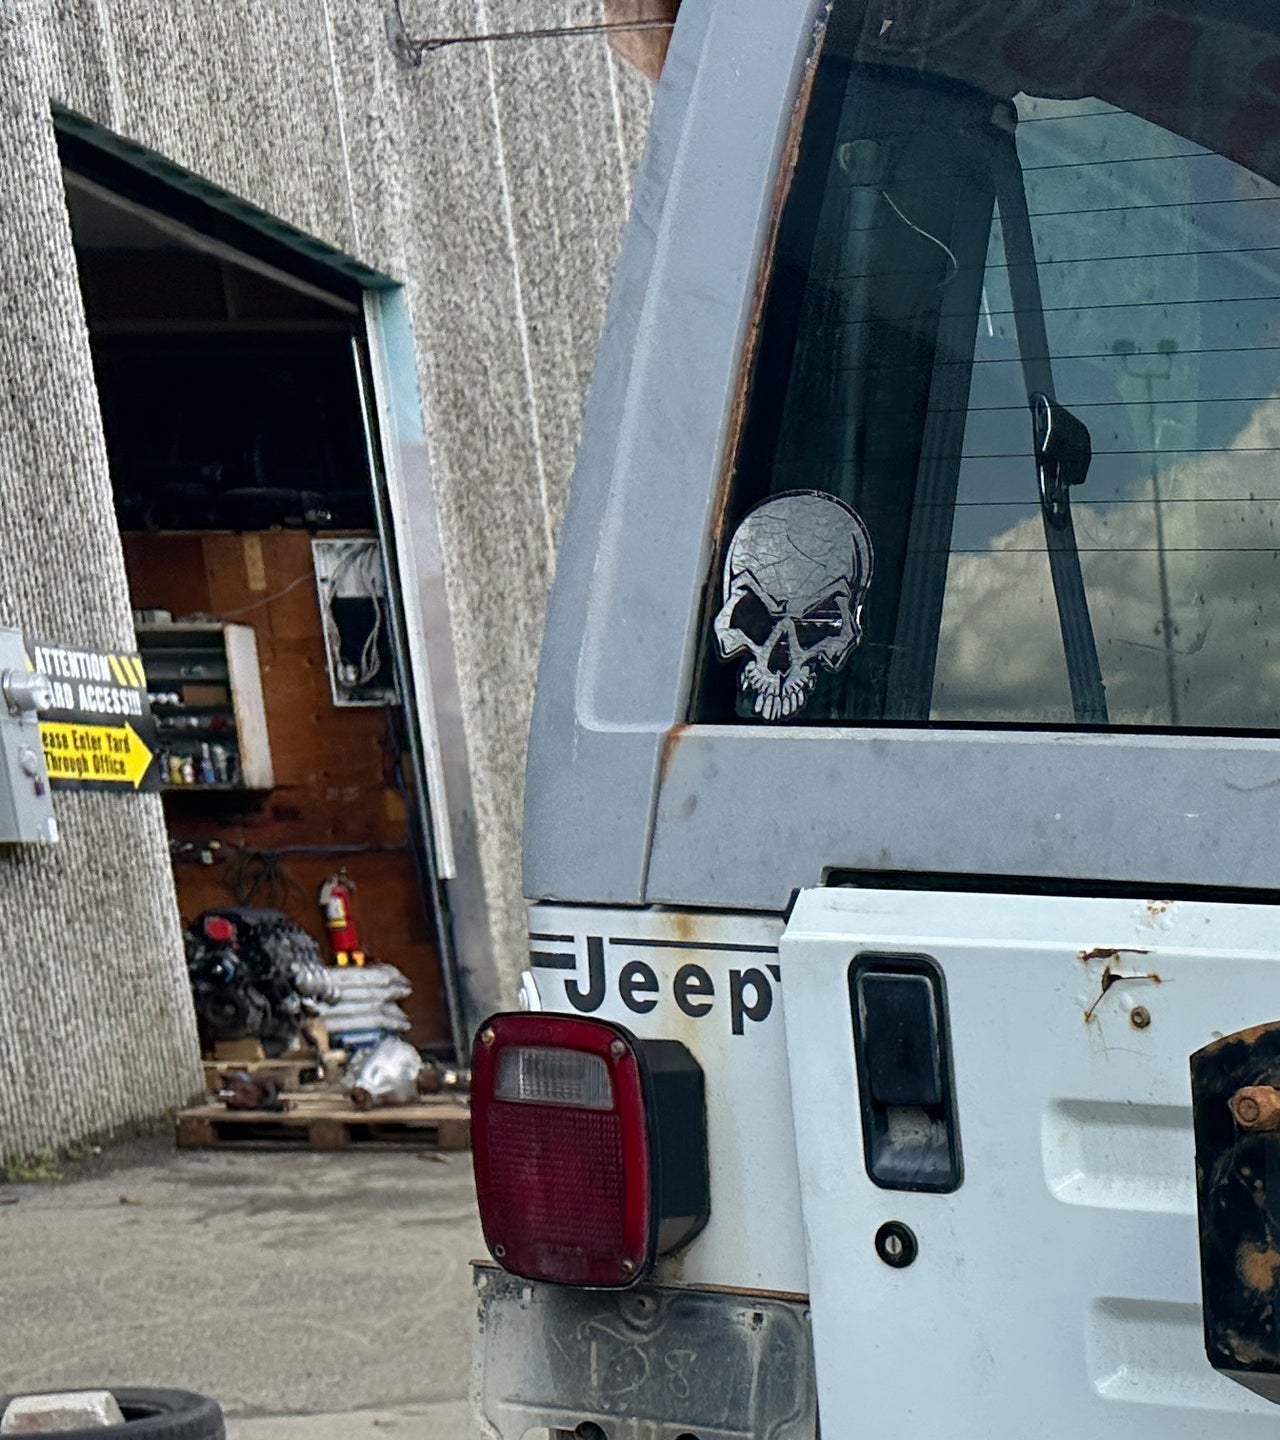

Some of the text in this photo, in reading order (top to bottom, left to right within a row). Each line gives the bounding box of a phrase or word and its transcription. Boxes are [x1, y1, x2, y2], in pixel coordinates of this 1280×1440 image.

[35, 646, 111, 682] ATTENTION
[51, 681, 143, 716] ARD ACCESS!!!
[42, 730, 131, 754] ease Enter Yard
[43, 751, 126, 777] Through Office
[564, 936, 774, 1035] Jeep
